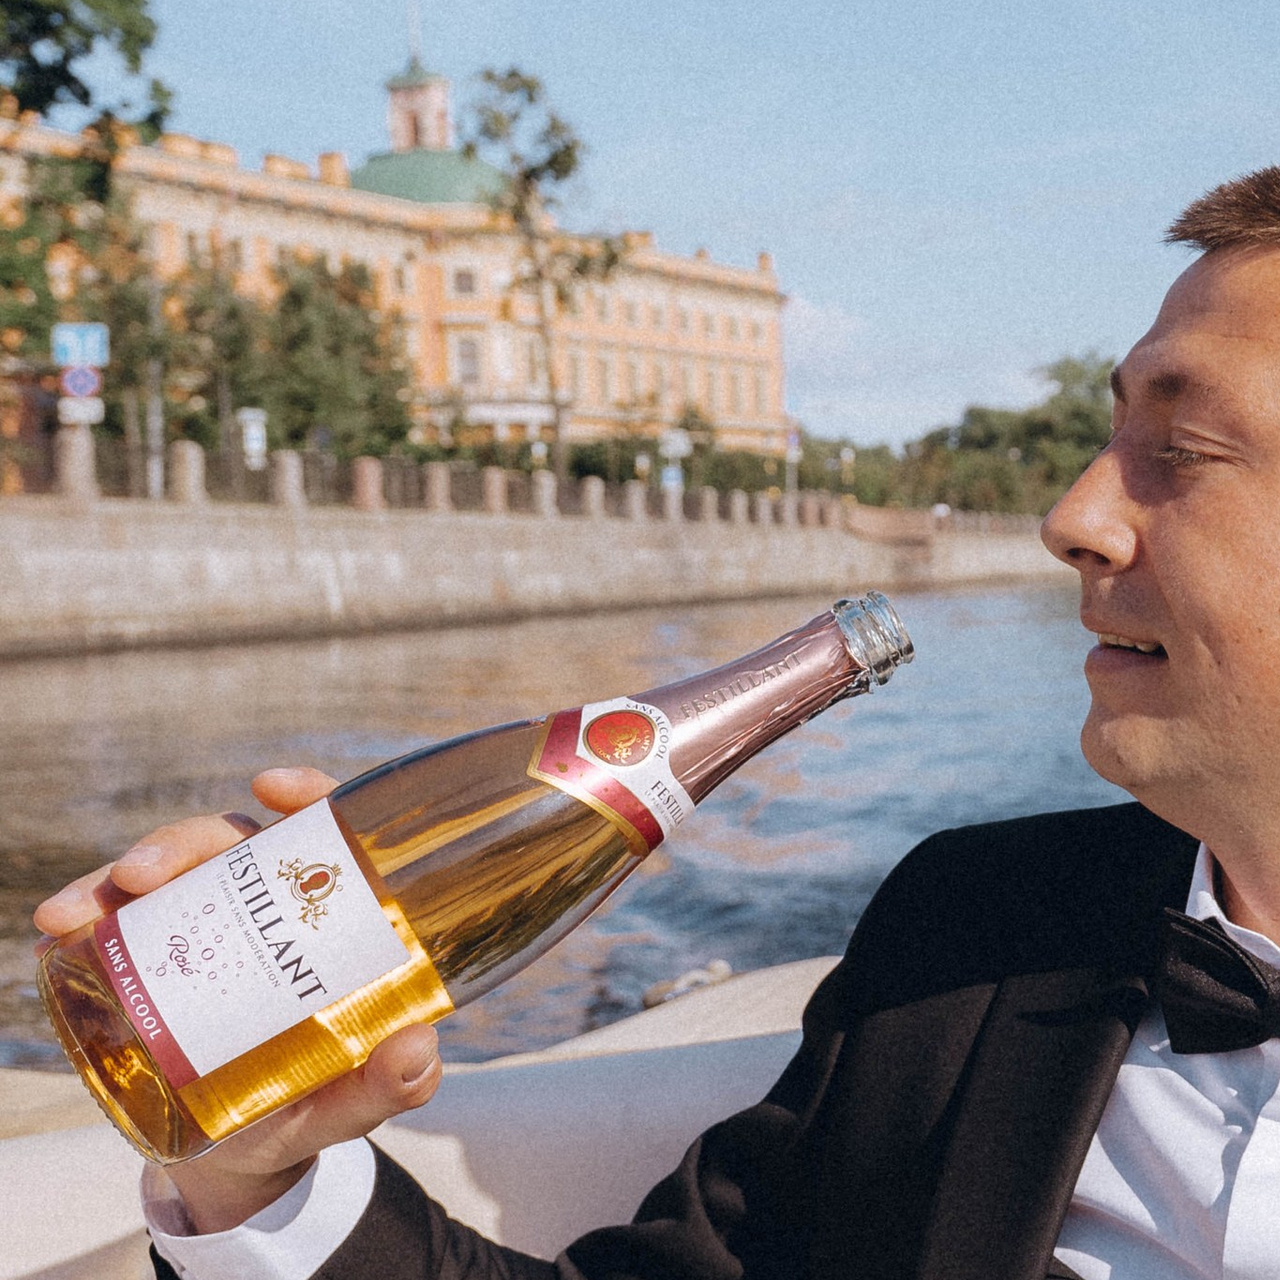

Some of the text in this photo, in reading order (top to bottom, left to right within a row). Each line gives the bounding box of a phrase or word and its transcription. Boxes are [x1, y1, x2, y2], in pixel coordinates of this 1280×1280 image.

[680, 654, 801, 720] FESTILLANT
[626, 703, 654, 716] SANS
[654, 716, 670, 760] ALCOOL
[226, 843, 327, 1001] FESTILLANT
[231, 906, 247, 928] SANS
[166, 935, 201, 977] Rosé
[105, 938, 162, 1040] SANS ALCOOL
